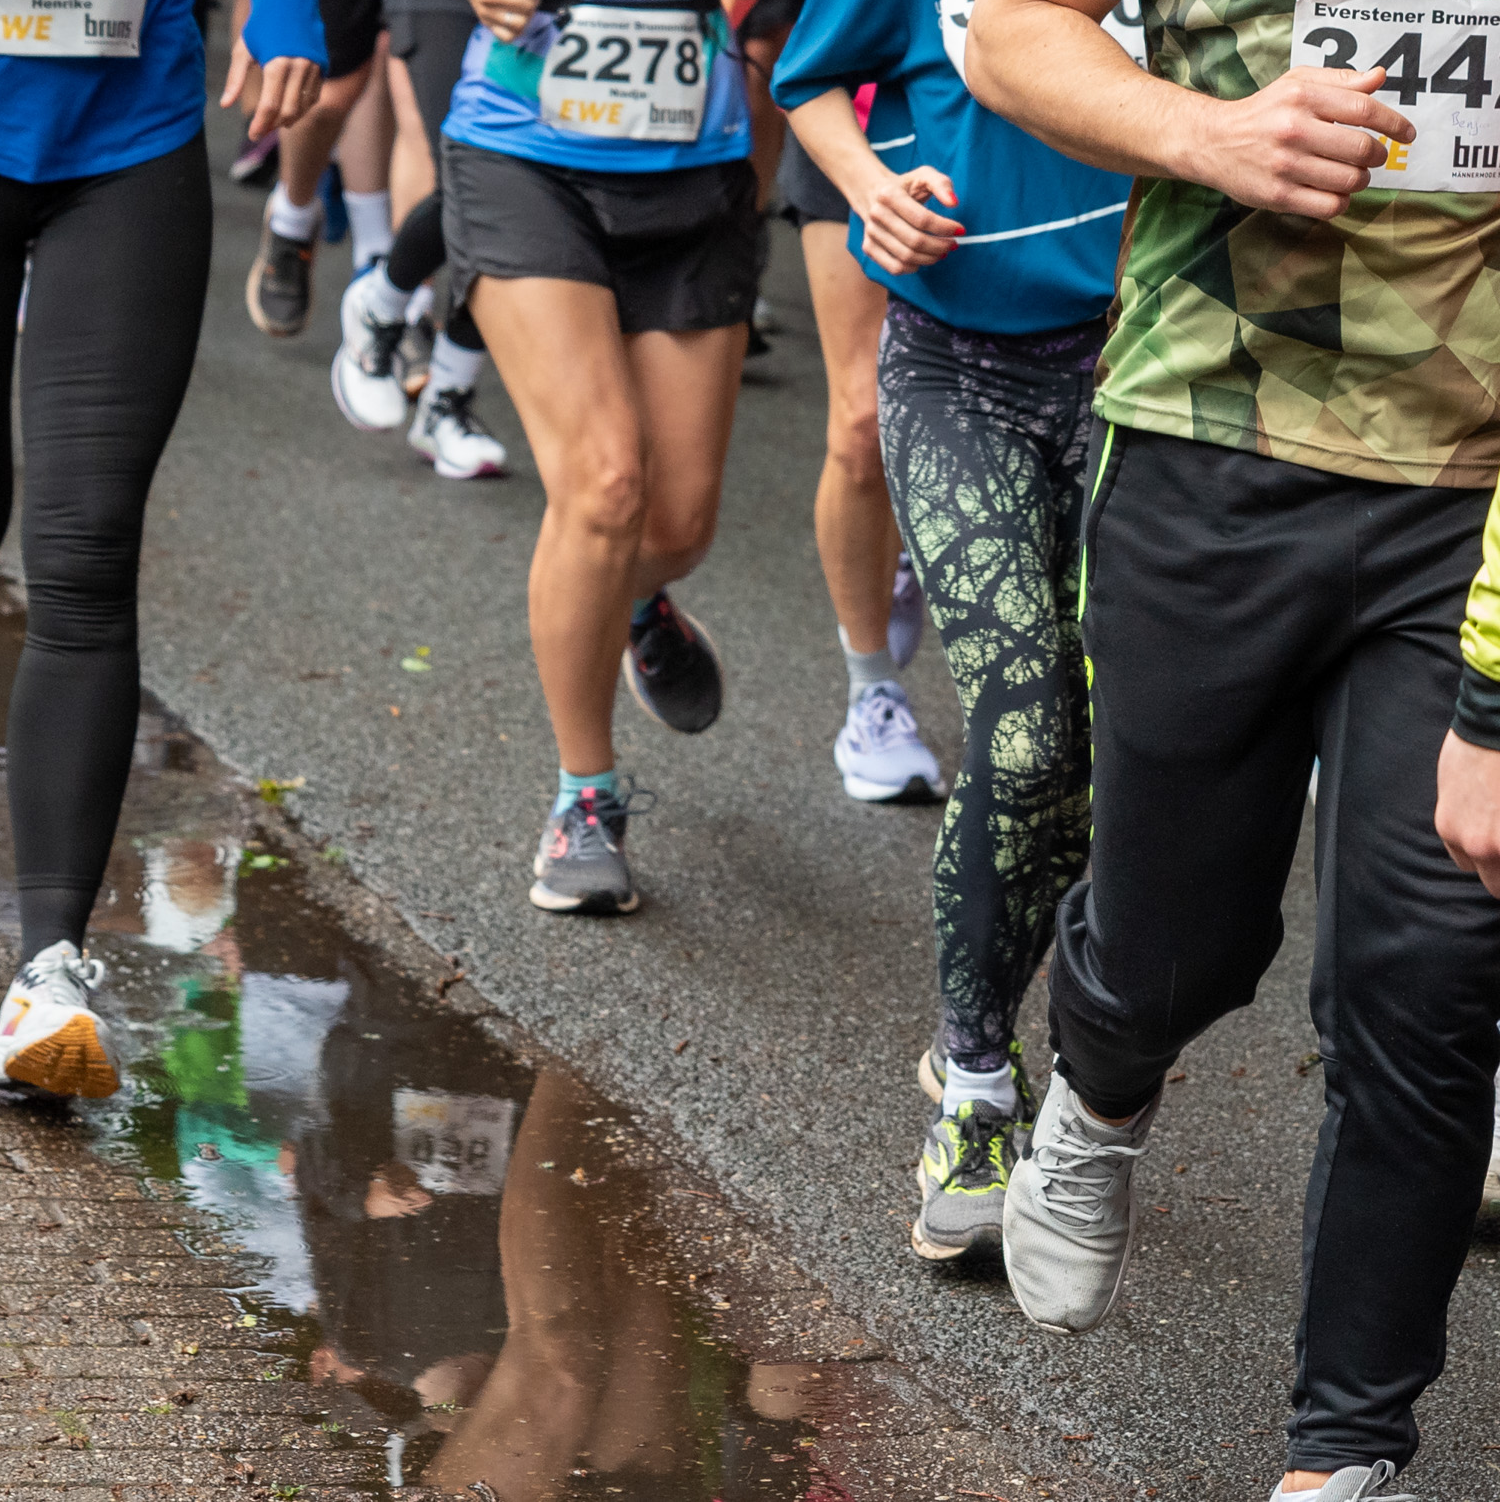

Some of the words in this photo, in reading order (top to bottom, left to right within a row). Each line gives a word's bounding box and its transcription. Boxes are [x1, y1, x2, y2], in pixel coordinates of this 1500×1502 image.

[1314, 2, 1426, 24] Everstener
[84, 12, 133, 39] bruns
[551, 33, 700, 86] 2278
[557, 99, 624, 125] EWE
[649, 102, 696, 125] bruns
[1451, 171, 1496, 179] MÄNNERMODE
